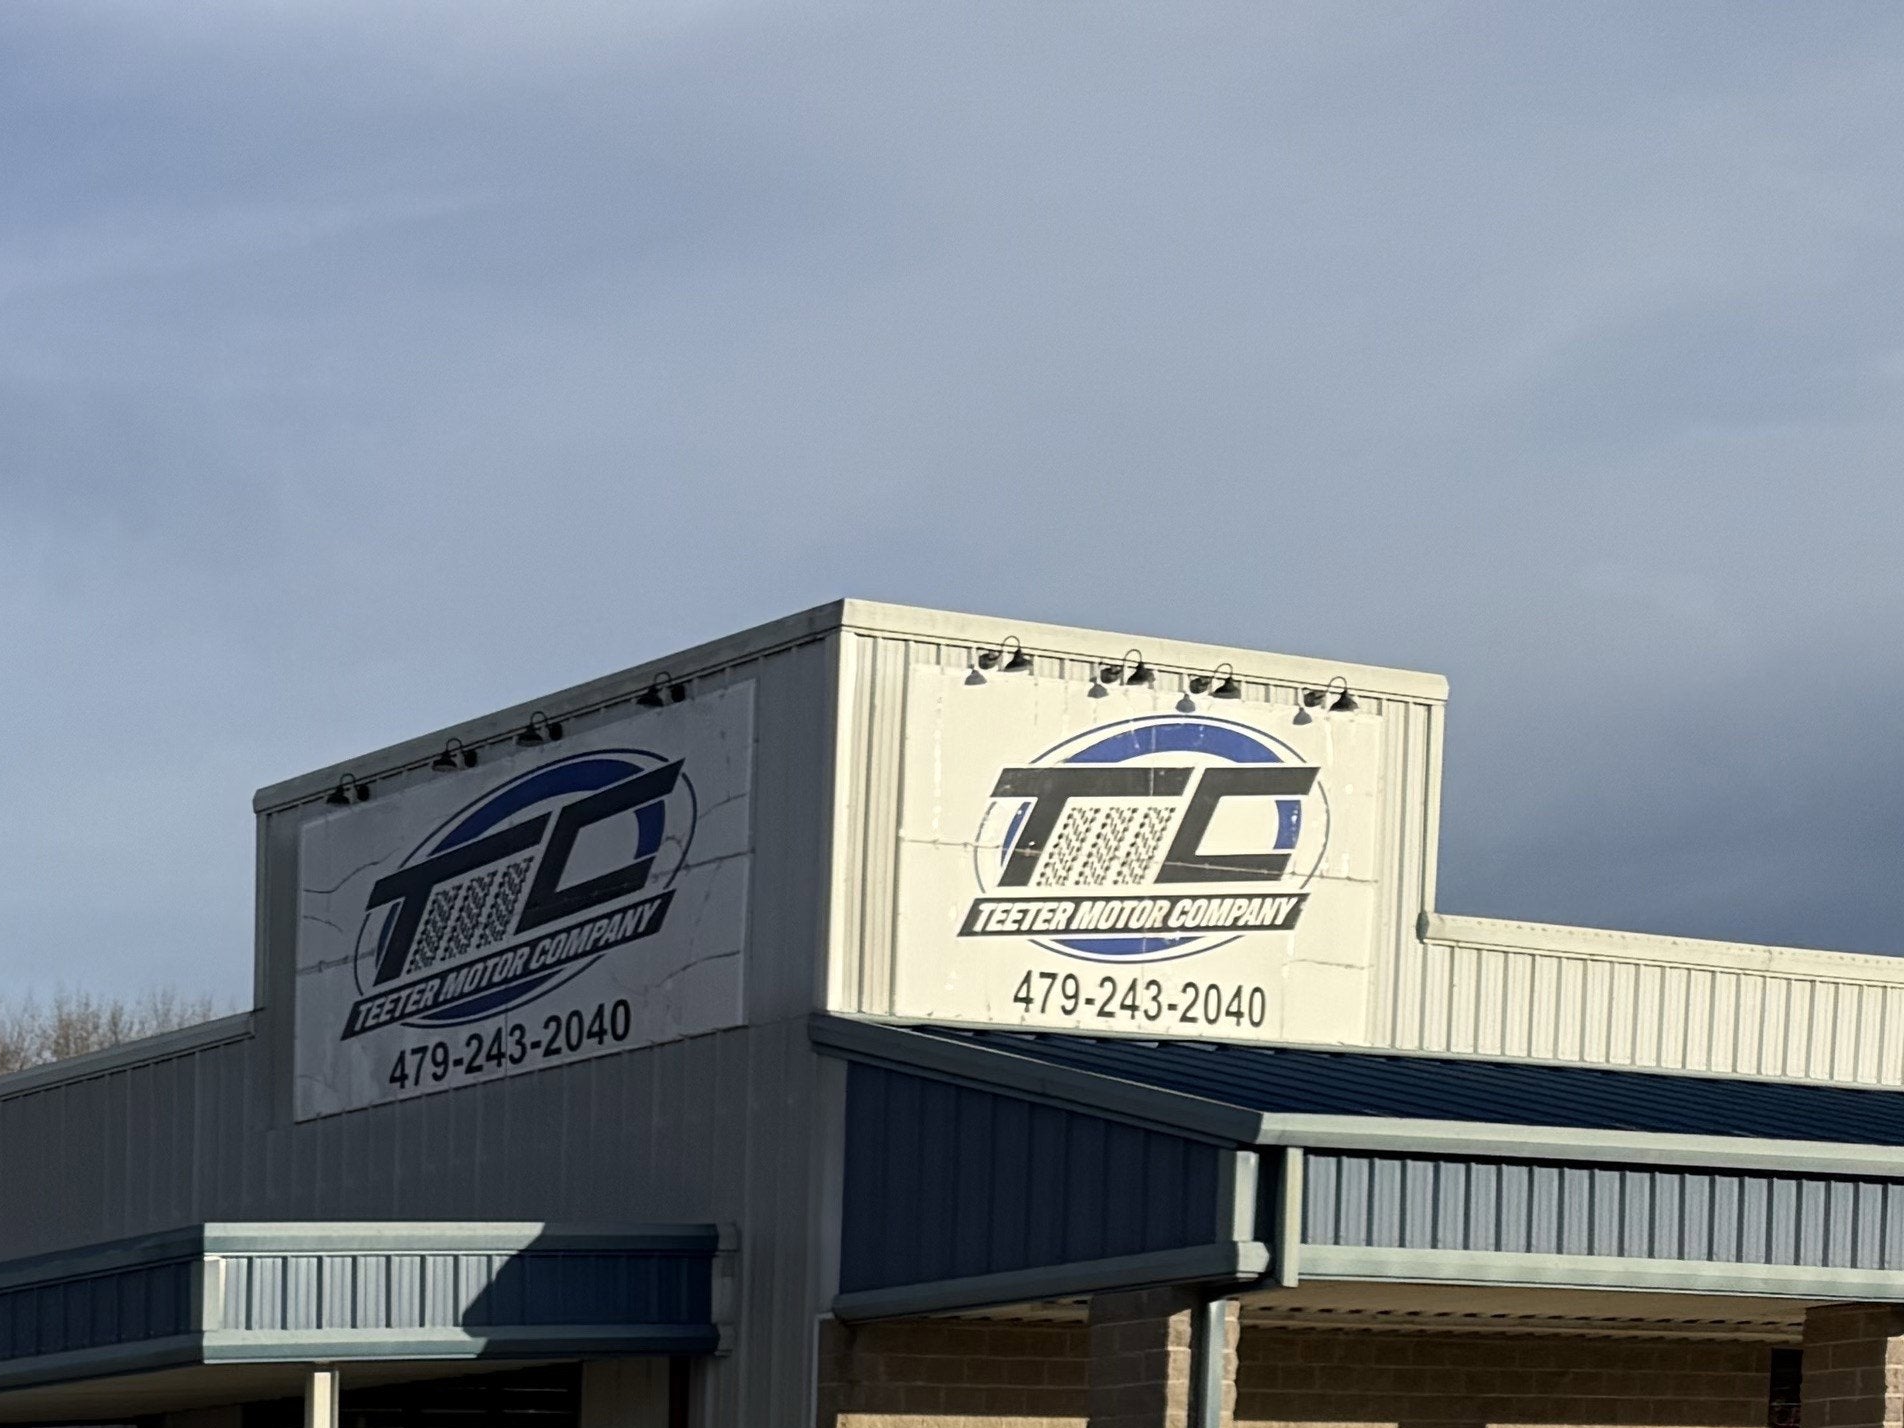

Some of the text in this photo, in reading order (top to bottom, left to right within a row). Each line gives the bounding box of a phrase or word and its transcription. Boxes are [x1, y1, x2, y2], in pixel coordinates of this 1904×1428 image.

[973, 896, 1298, 932] TEETER MOTOR COMPANY
[354, 898, 662, 1031] TEETER MOTOR COMPANY
[1013, 970, 1267, 1028] 479-243-2040
[389, 998, 633, 1090] 479-243-2040
